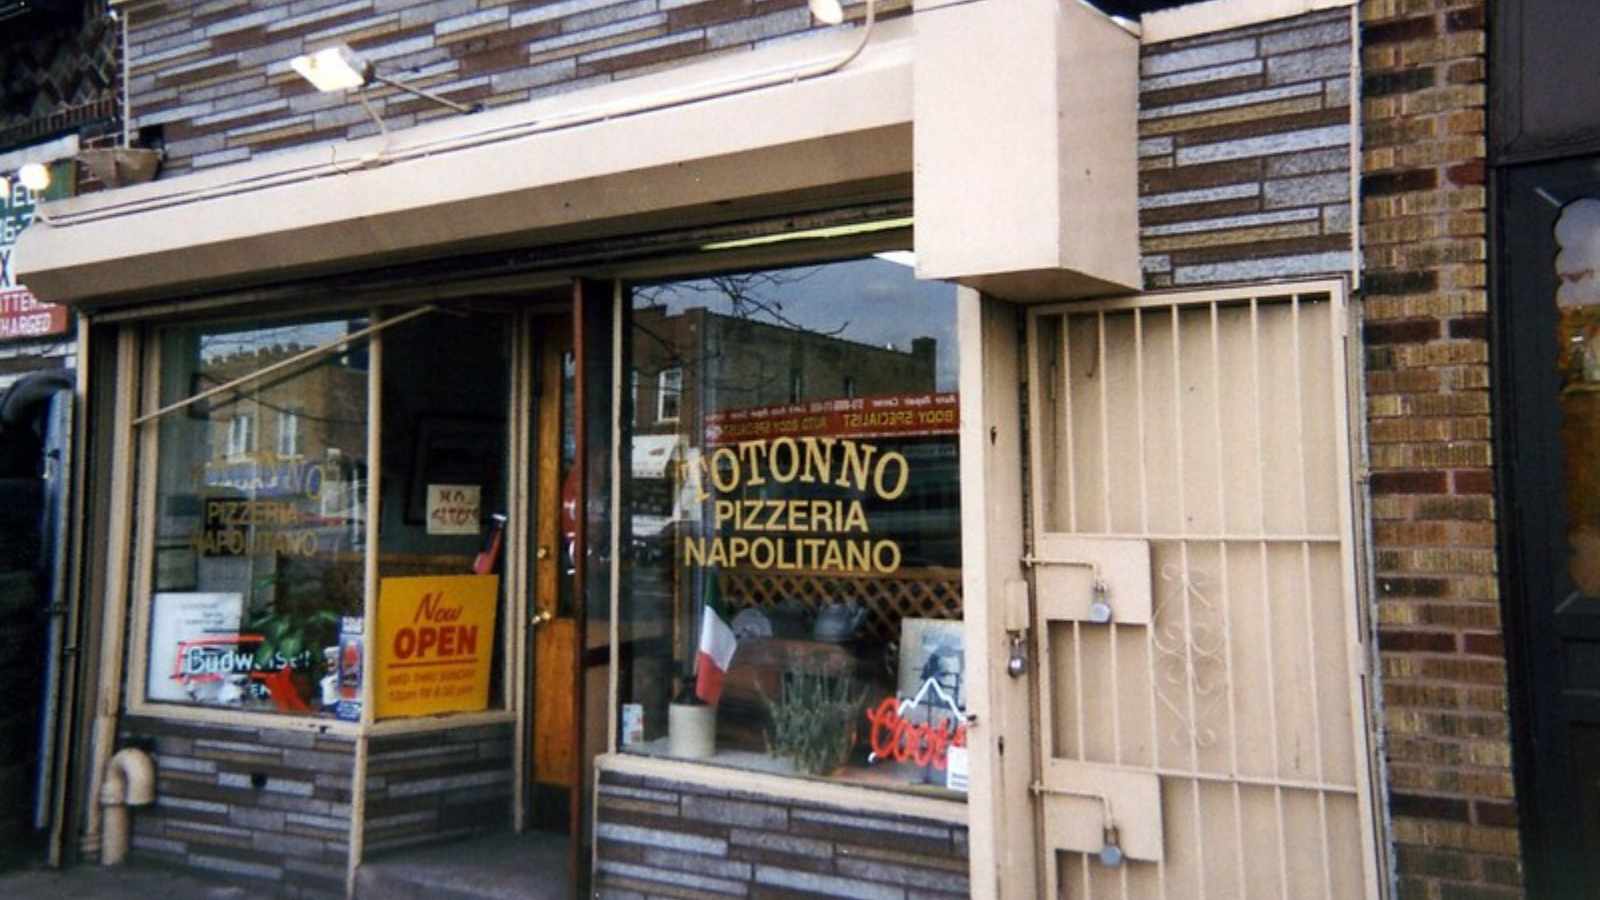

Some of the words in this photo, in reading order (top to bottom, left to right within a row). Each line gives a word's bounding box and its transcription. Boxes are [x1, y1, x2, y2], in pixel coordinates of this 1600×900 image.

[679, 435, 909, 503] TOTONNO
[714, 498, 869, 533] PIZZERIA
[192, 528, 320, 556] NAPOITANO
[684, 535, 902, 574] NAPOLITANO
[414, 591, 464, 623] Now
[393, 624, 478, 660] OPEN
